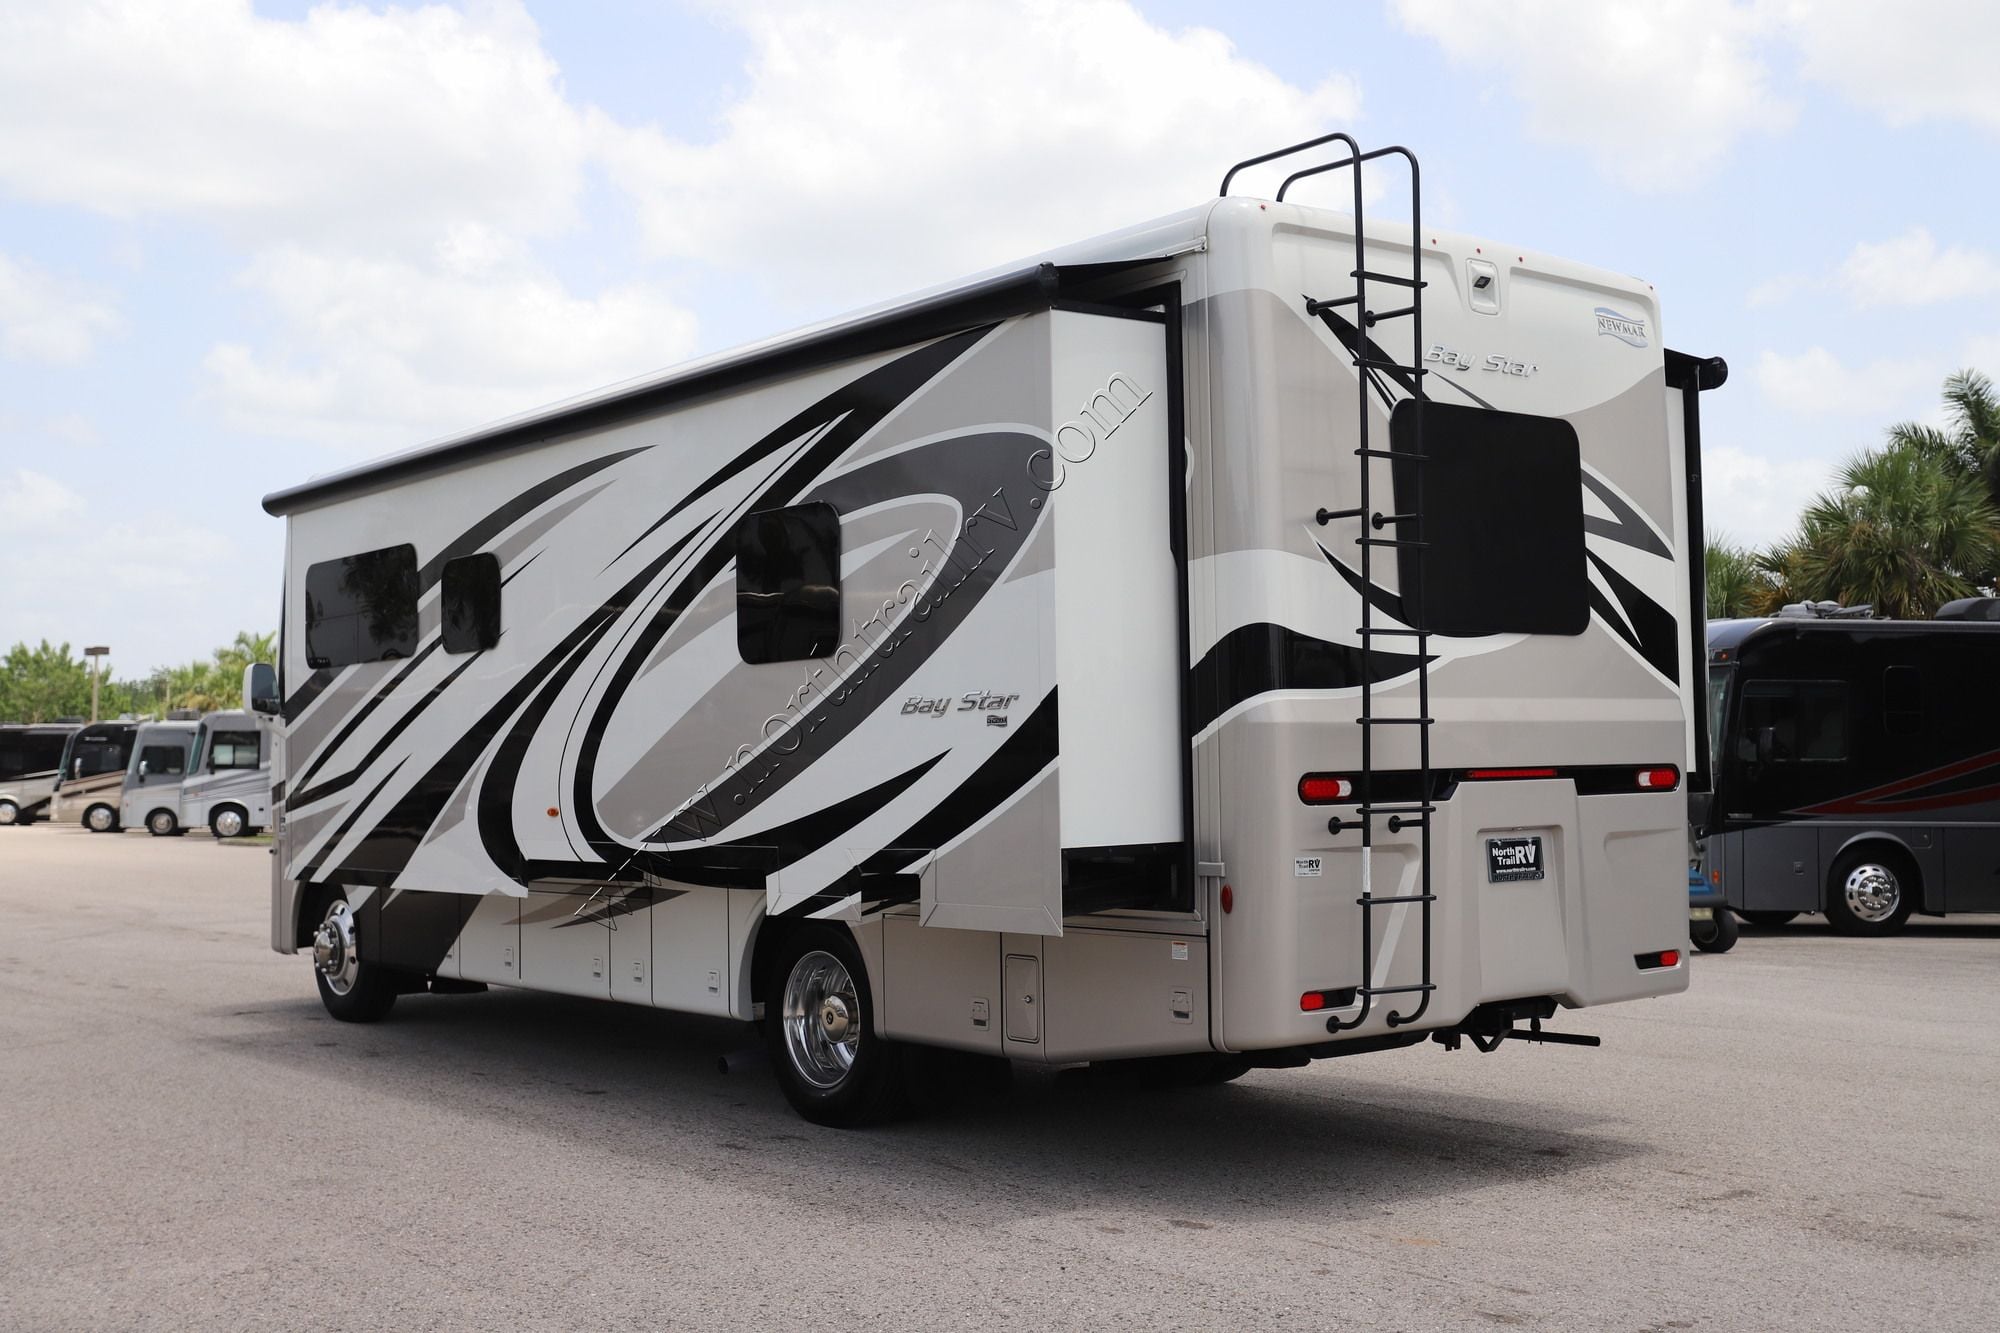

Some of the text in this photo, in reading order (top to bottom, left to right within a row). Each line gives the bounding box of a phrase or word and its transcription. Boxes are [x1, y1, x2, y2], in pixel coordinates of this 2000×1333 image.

[1598, 317, 1646, 338] NEWMAR
[1424, 344, 1539, 378] Bay Star
[900, 690, 1020, 719] Bay Star
[1492, 847, 1515, 857] North
[1497, 856, 1515, 866] Trail
[1515, 844, 1536, 865] RV
[1308, 859, 1321, 869] RV
